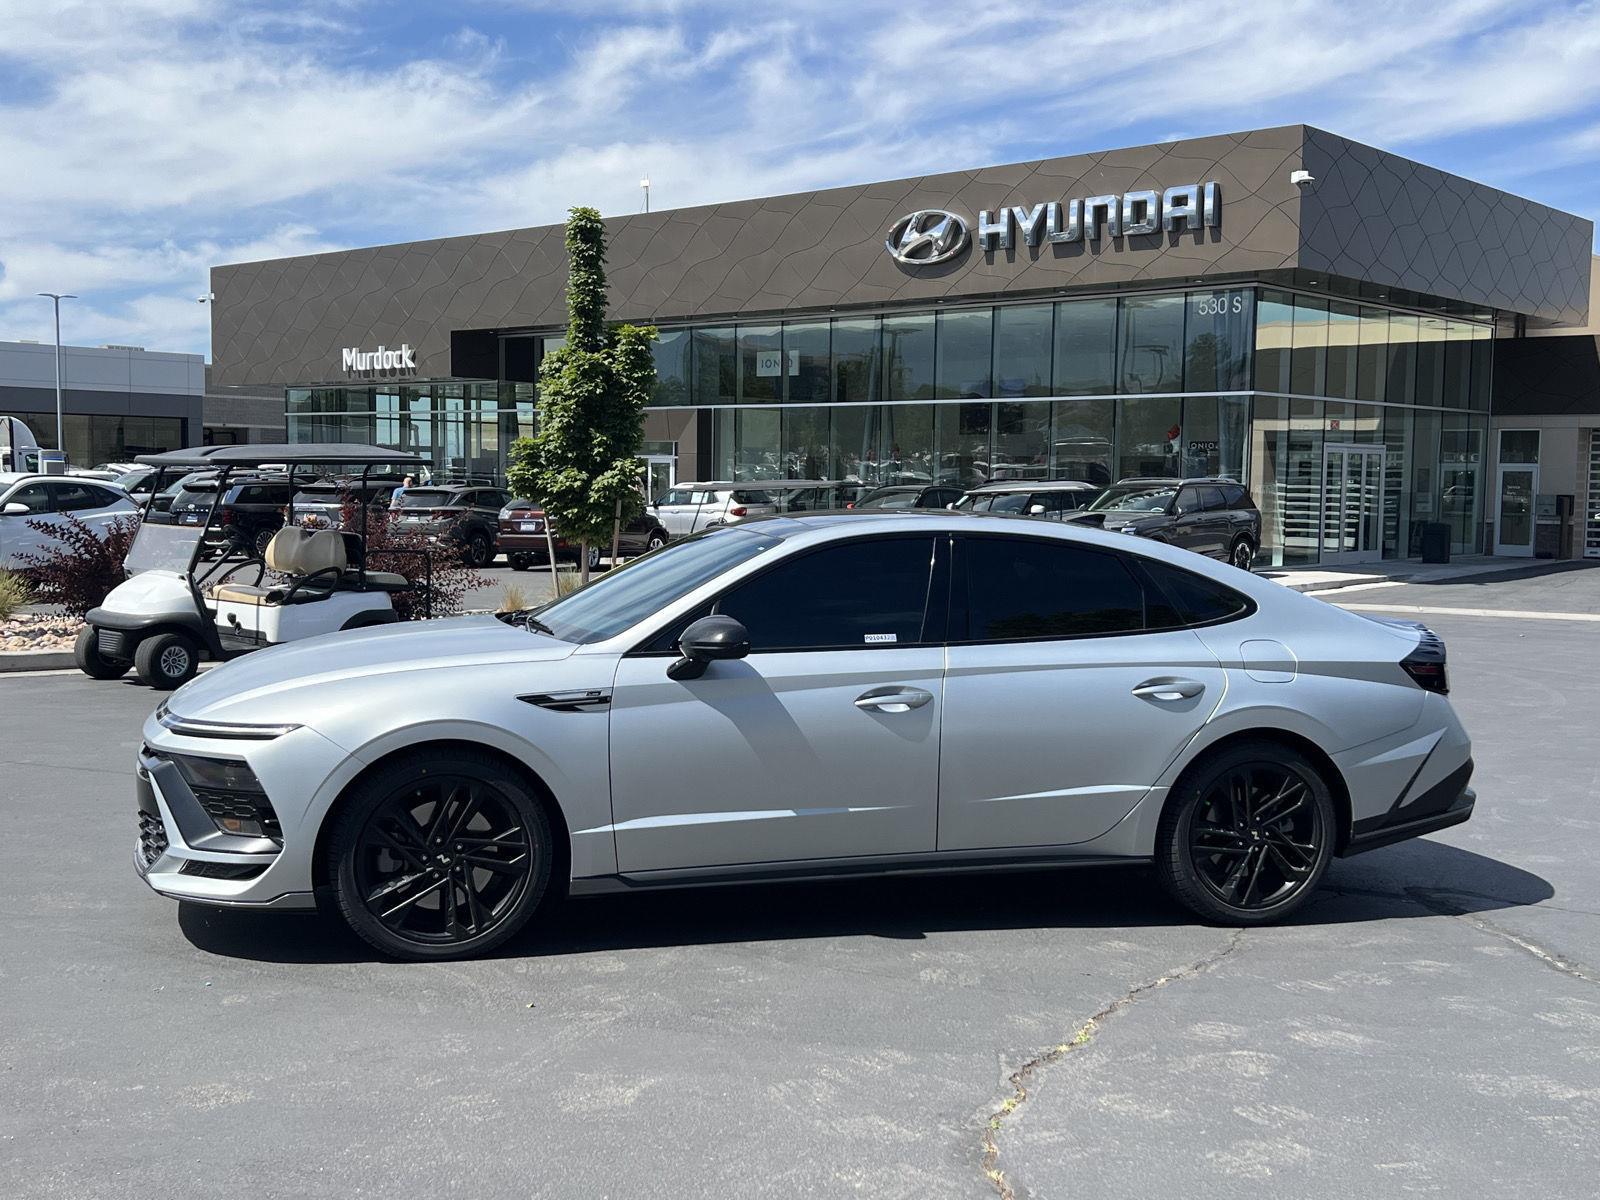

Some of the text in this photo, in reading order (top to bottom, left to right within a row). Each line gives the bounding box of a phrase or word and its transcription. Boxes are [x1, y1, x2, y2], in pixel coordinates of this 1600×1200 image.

[978, 181, 1221, 251] HYUNDAI
[1198, 296, 1242, 315] 530 S
[342, 343, 416, 372] Murdock
